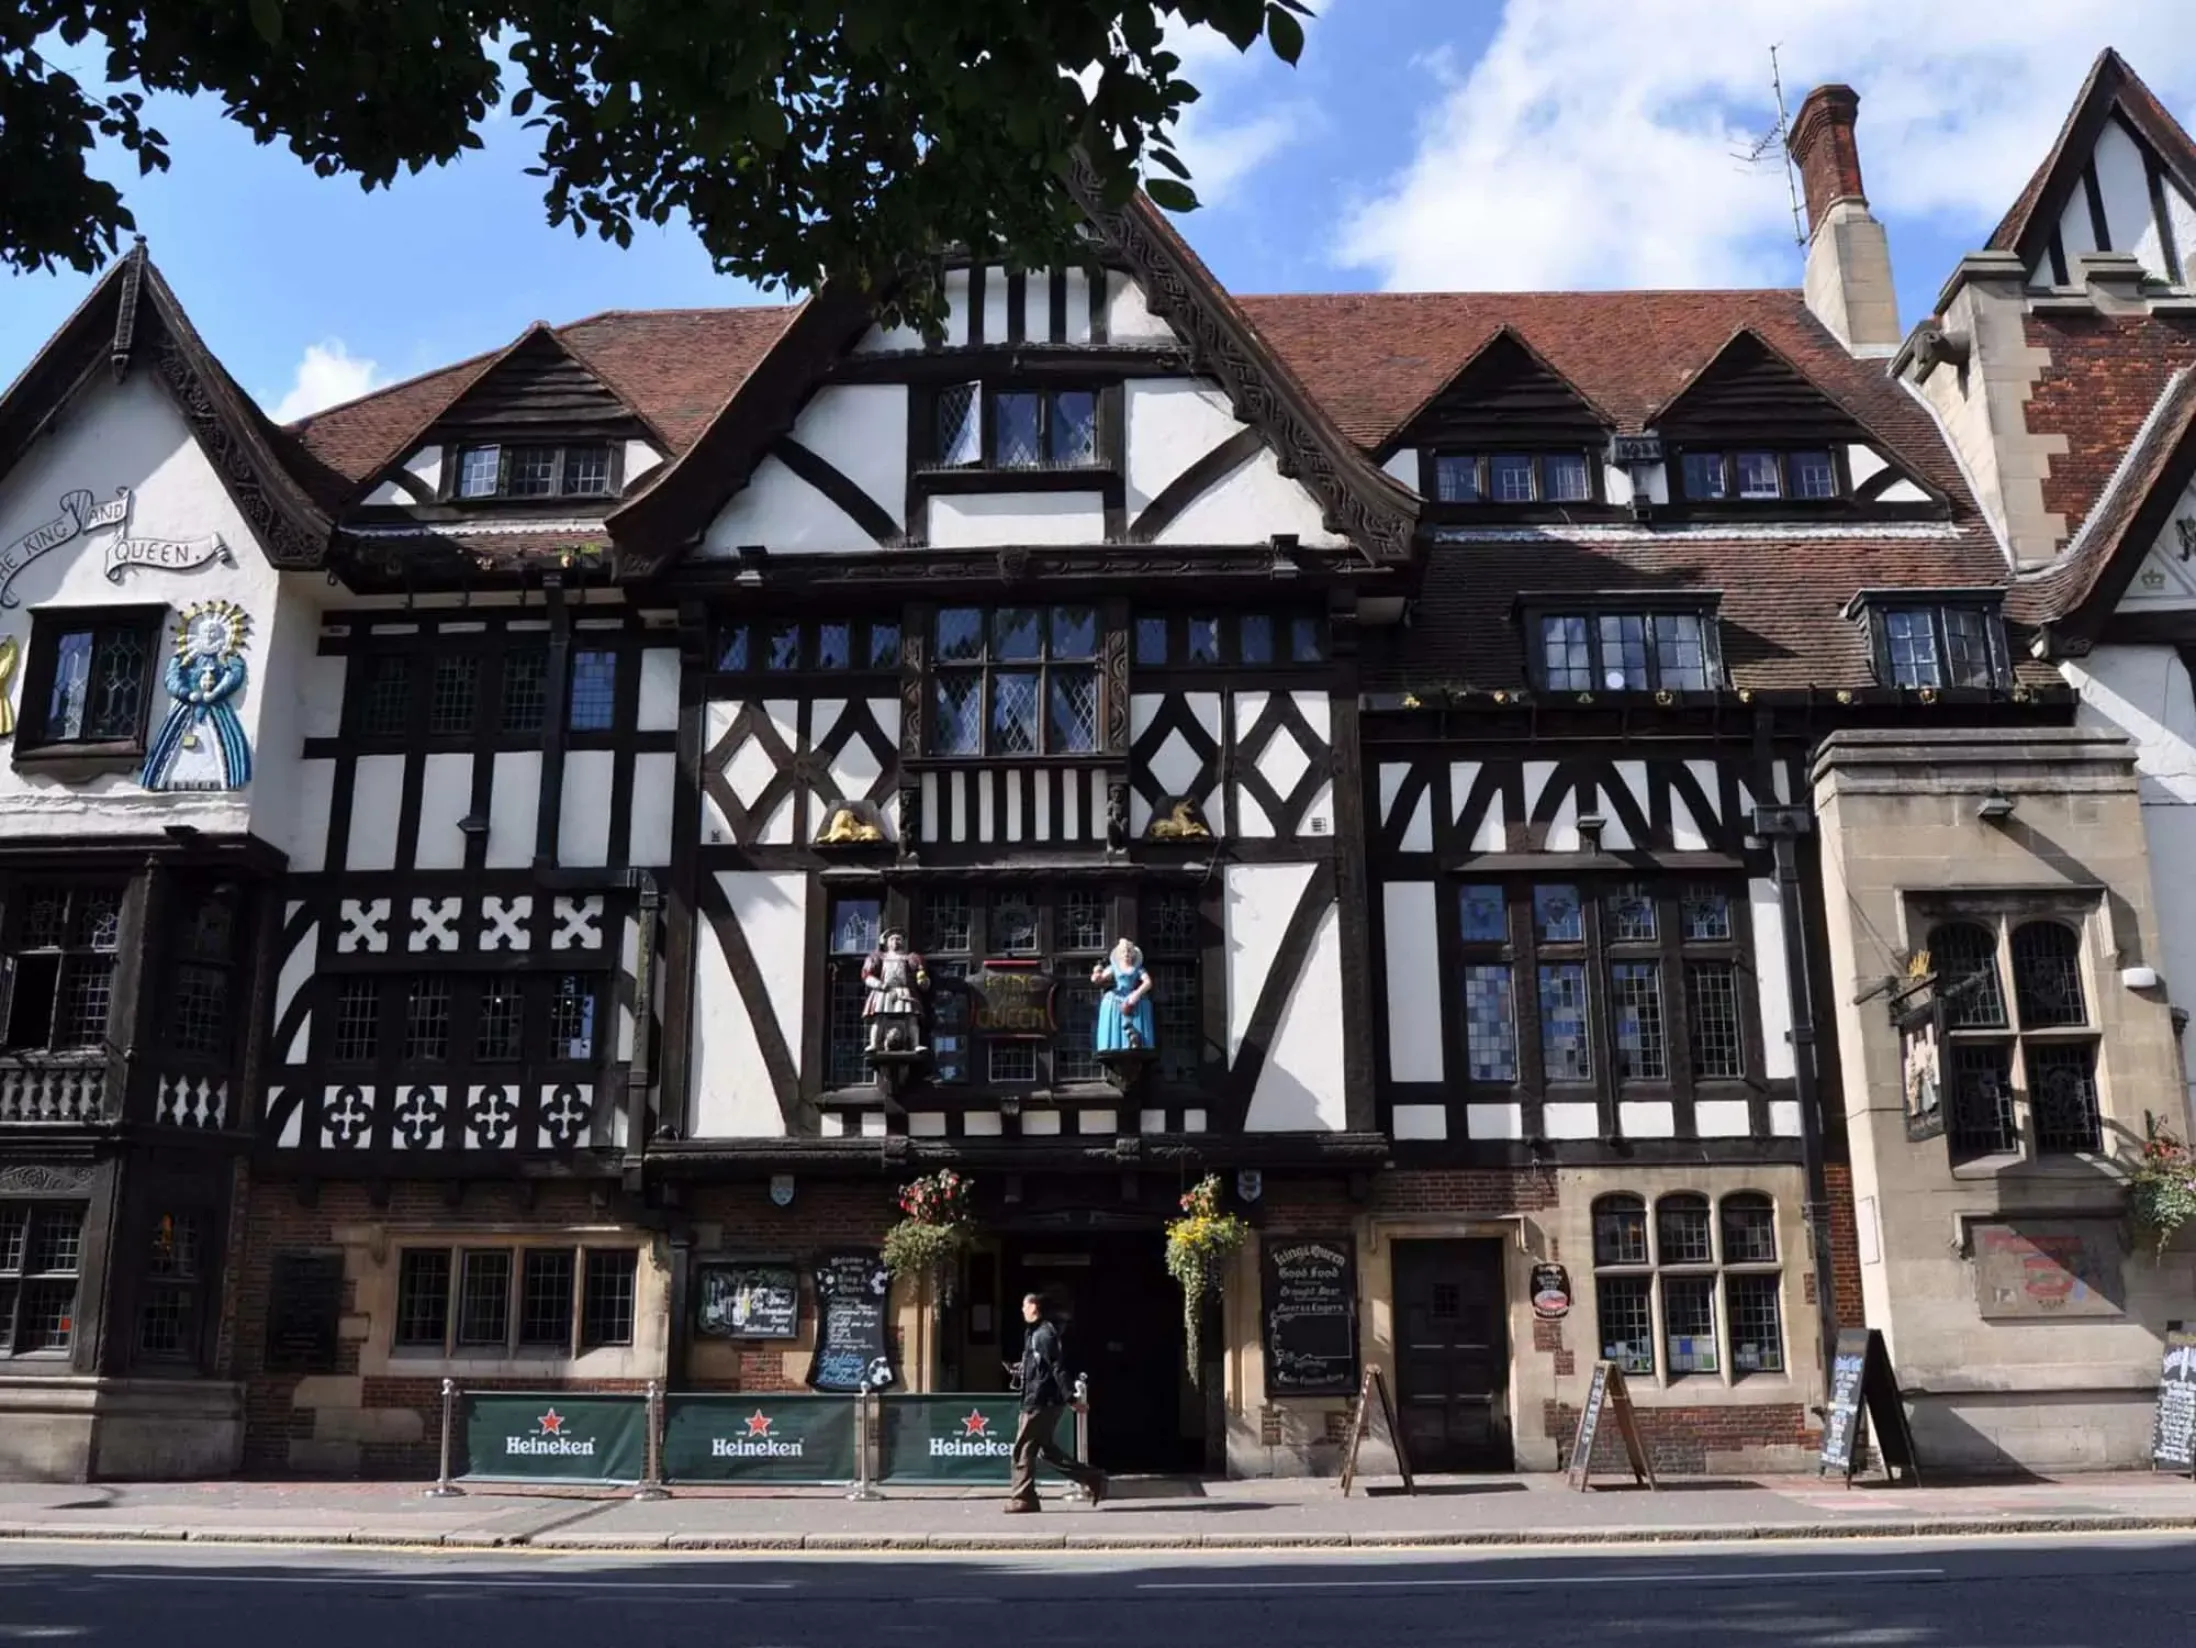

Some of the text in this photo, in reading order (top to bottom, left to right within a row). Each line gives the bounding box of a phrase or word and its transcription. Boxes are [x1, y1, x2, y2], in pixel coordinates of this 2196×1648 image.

[23, 520, 68, 555] KING
[88, 503, 123, 522] AND
[1279, 1267, 1339, 1279] Good Food
[506, 1437, 594, 1455] Heineken
[712, 1438, 802, 1456] Heineken
